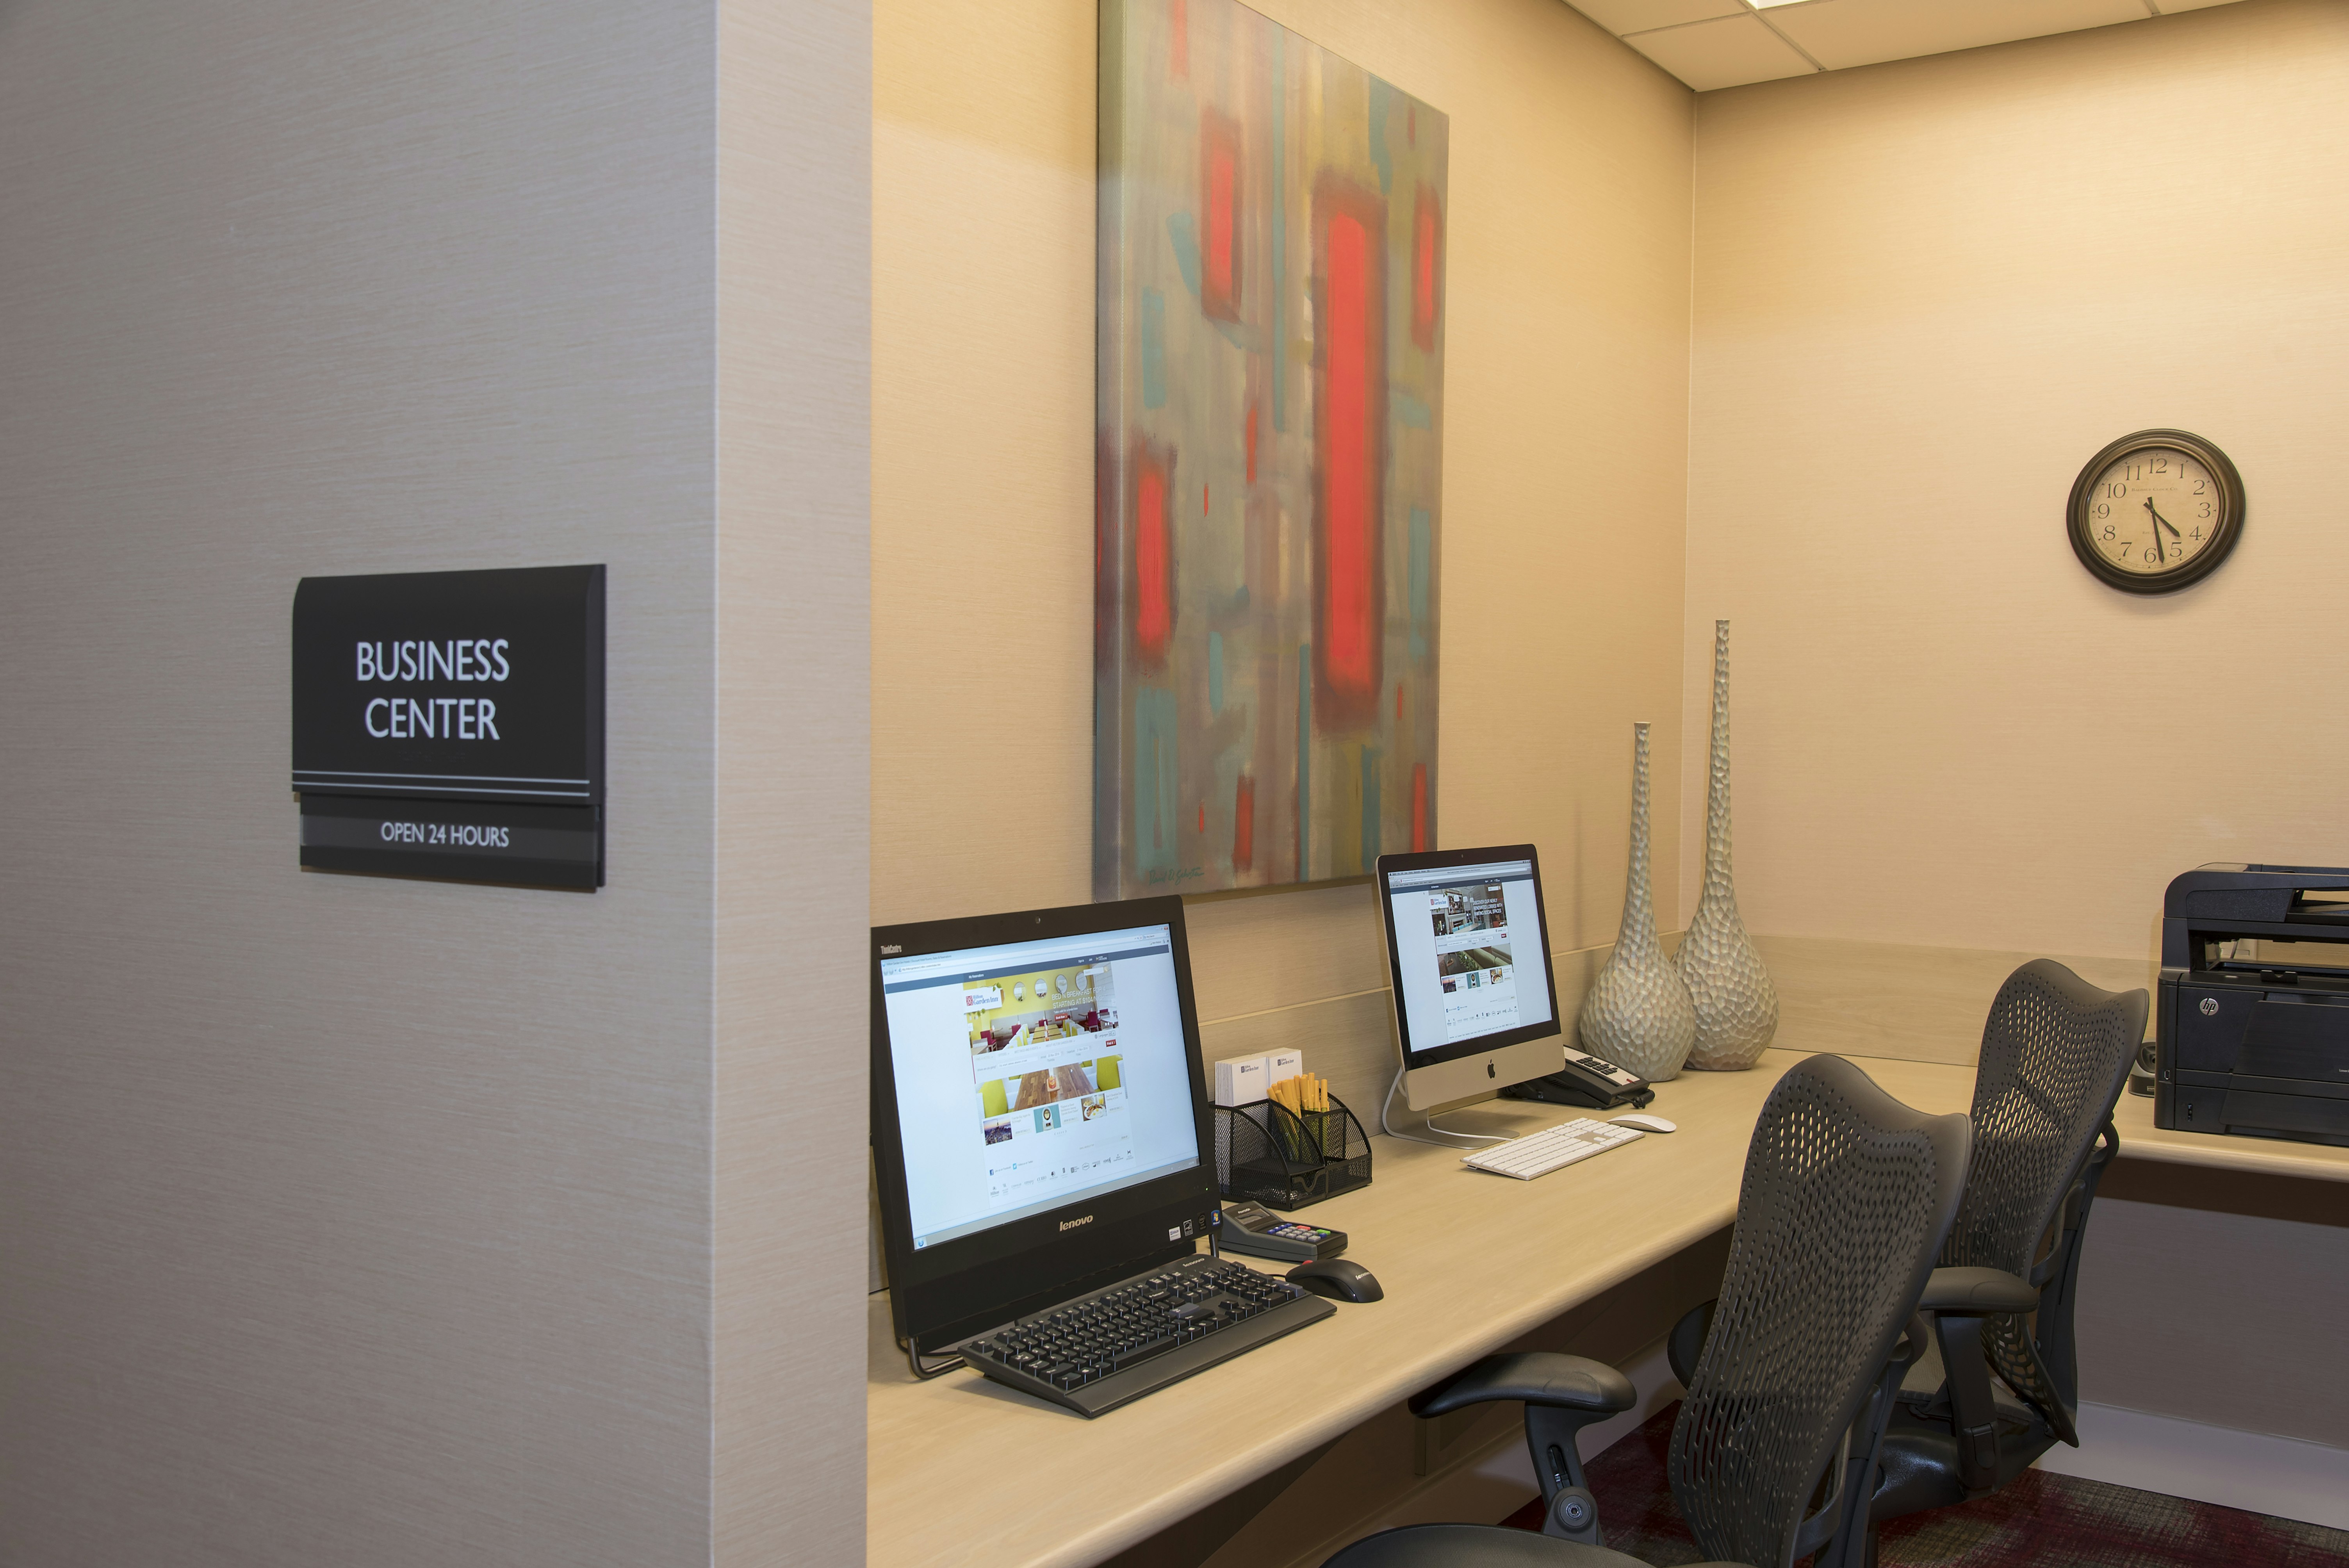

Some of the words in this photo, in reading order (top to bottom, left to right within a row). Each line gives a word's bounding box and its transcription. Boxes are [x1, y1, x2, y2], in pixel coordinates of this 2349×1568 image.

[2125, 465, 2140, 481] 11
[2149, 458, 2167, 474] 12
[2179, 463, 2184, 479] 1
[2107, 483, 2126, 498] 10
[2193, 480, 2205, 495] 2
[2098, 504, 2110, 519] 9
[2198, 502, 2211, 518] 3
[2103, 526, 2116, 540] 8
[2189, 526, 2202, 541] 4
[2120, 542, 2132, 556] 7
[2144, 548, 2156, 563] 6
[2169, 542, 2182, 557] 5
[356, 639, 510, 682] BUSINESS
[365, 698, 500, 740] CENTER
[381, 822, 425, 843] OPEN
[428, 824, 447, 845] 24
[450, 825, 509, 847] HOURS
[1066, 988, 1092, 998] BREAKFAST
[1052, 1000, 1075, 1009] STARTING
[2201, 998, 2217, 1015] hp
[1059, 1215, 1093, 1231] lenovo
[1182, 1258, 1205, 1267] lenovo
